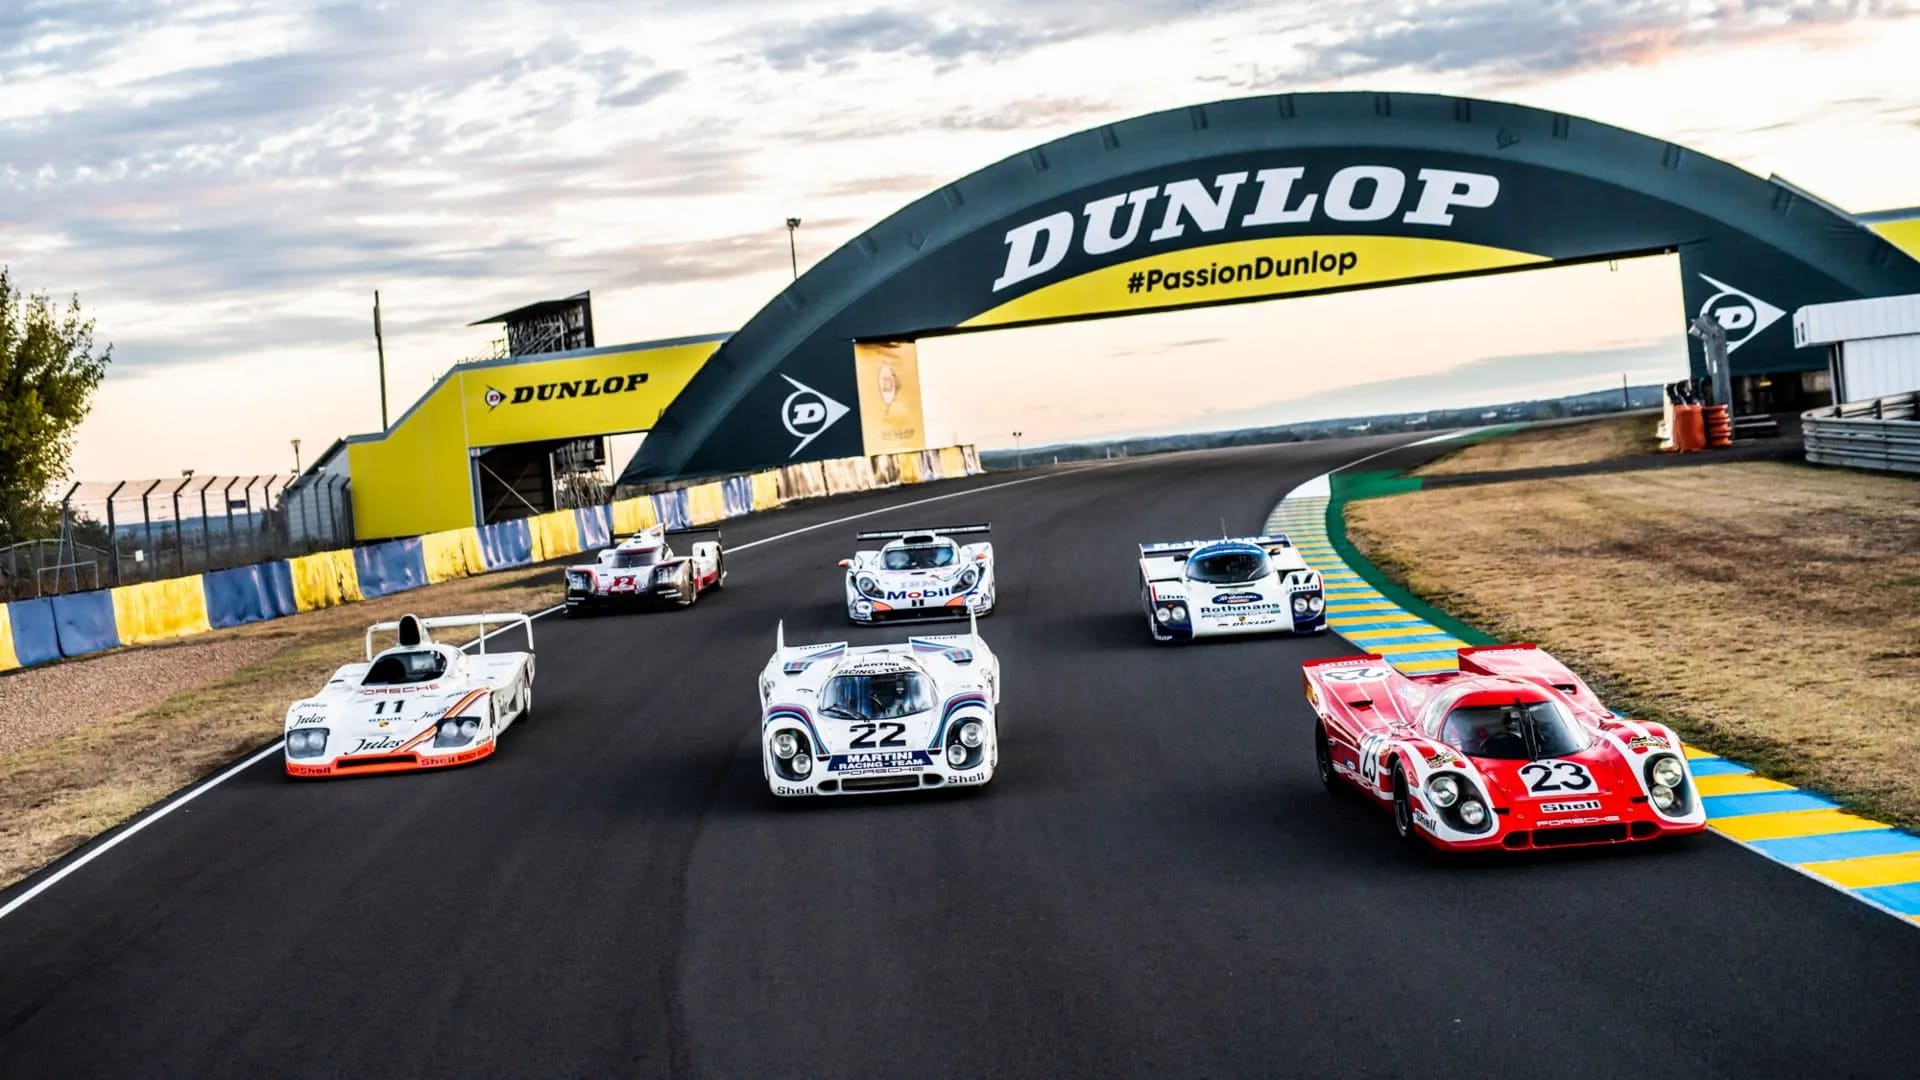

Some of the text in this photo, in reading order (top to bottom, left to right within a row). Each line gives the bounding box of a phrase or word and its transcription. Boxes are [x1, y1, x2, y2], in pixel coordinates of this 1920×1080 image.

[992, 165, 1500, 293] DUNLOP
[1126, 247, 1358, 295] #PassionDunlop
[510, 373, 649, 404] DUNLOP
[887, 587, 950, 600] Mobil
[1200, 603, 1280, 613] Rothmans
[853, 661, 900, 669] MARTINI
[359, 683, 440, 696] PORSCHE
[374, 700, 405, 715] 11
[289, 713, 327, 729] Jules
[849, 722, 907, 749] 22
[345, 736, 405, 755] Jules
[421, 756, 456, 766] Shell
[847, 752, 914, 763] MARTINI
[1363, 735, 1384, 784] 23
[300, 767, 332, 775] Shell
[838, 767, 924, 776] PORSCHE
[1521, 763, 1592, 792] 23
[948, 772, 985, 784] Shell
[777, 785, 814, 795] Shell
[1542, 800, 1600, 812] Shell
[1415, 809, 1437, 832] Shell
[1536, 815, 1621, 827] PORSCHE
